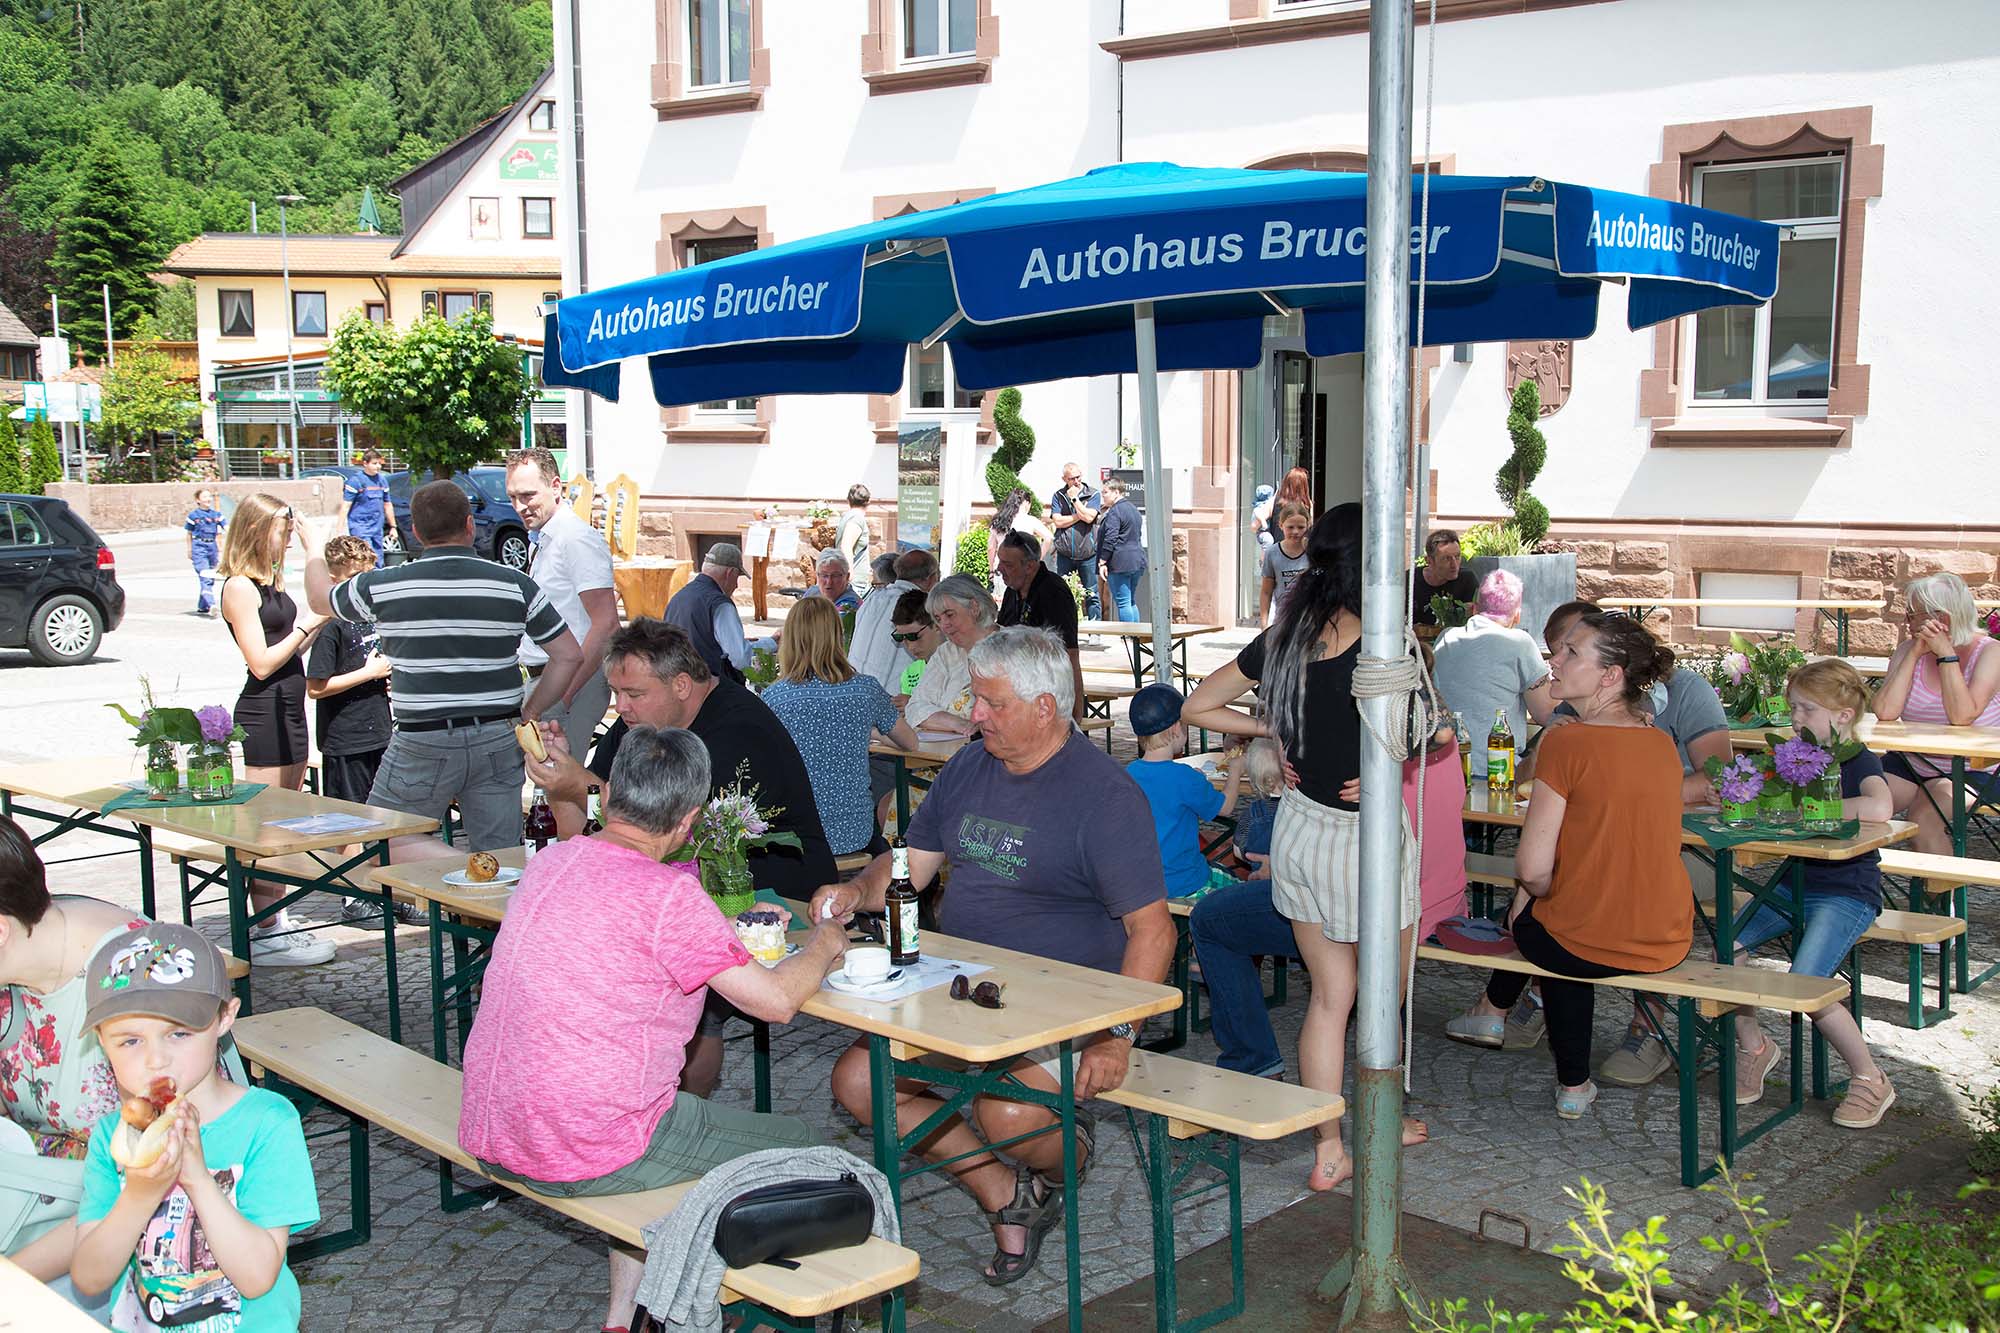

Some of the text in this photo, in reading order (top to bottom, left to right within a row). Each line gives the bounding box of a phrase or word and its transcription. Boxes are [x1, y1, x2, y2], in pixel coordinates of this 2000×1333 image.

[1019, 220, 1451, 289] Autohaus Brucer
[1586, 210, 1761, 271] Autohaus Brucher
[586, 275, 830, 344] Autohaus Brucher
[1001, 842, 1012, 852] 79
[171, 1205, 184, 1213] WAY
[172, 1196, 186, 1204] ONE
